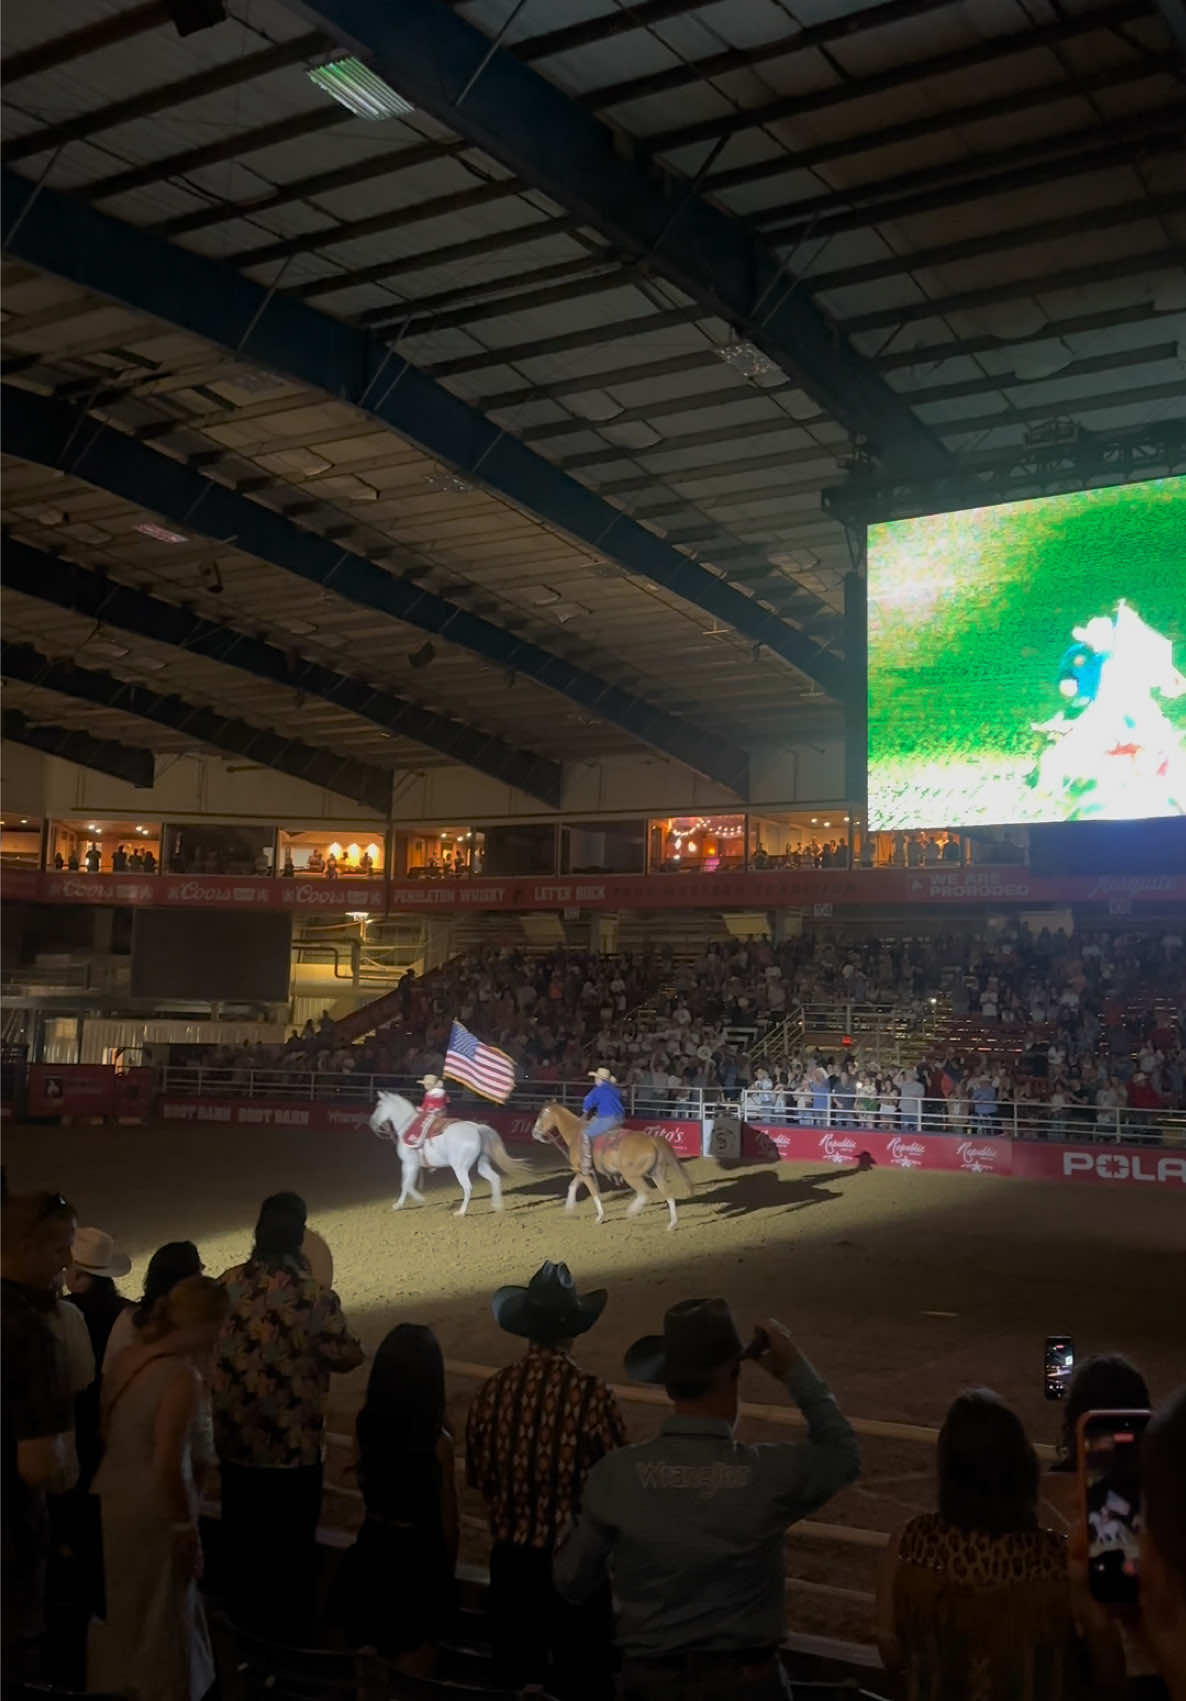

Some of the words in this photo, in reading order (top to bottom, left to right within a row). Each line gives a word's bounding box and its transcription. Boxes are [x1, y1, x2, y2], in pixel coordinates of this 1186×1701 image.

[177, 881, 232, 901] Coors
[295, 884, 345, 904] Coors
[644, 1125, 686, 1144] Tito's
[1063, 1151, 1186, 1184] POLA
